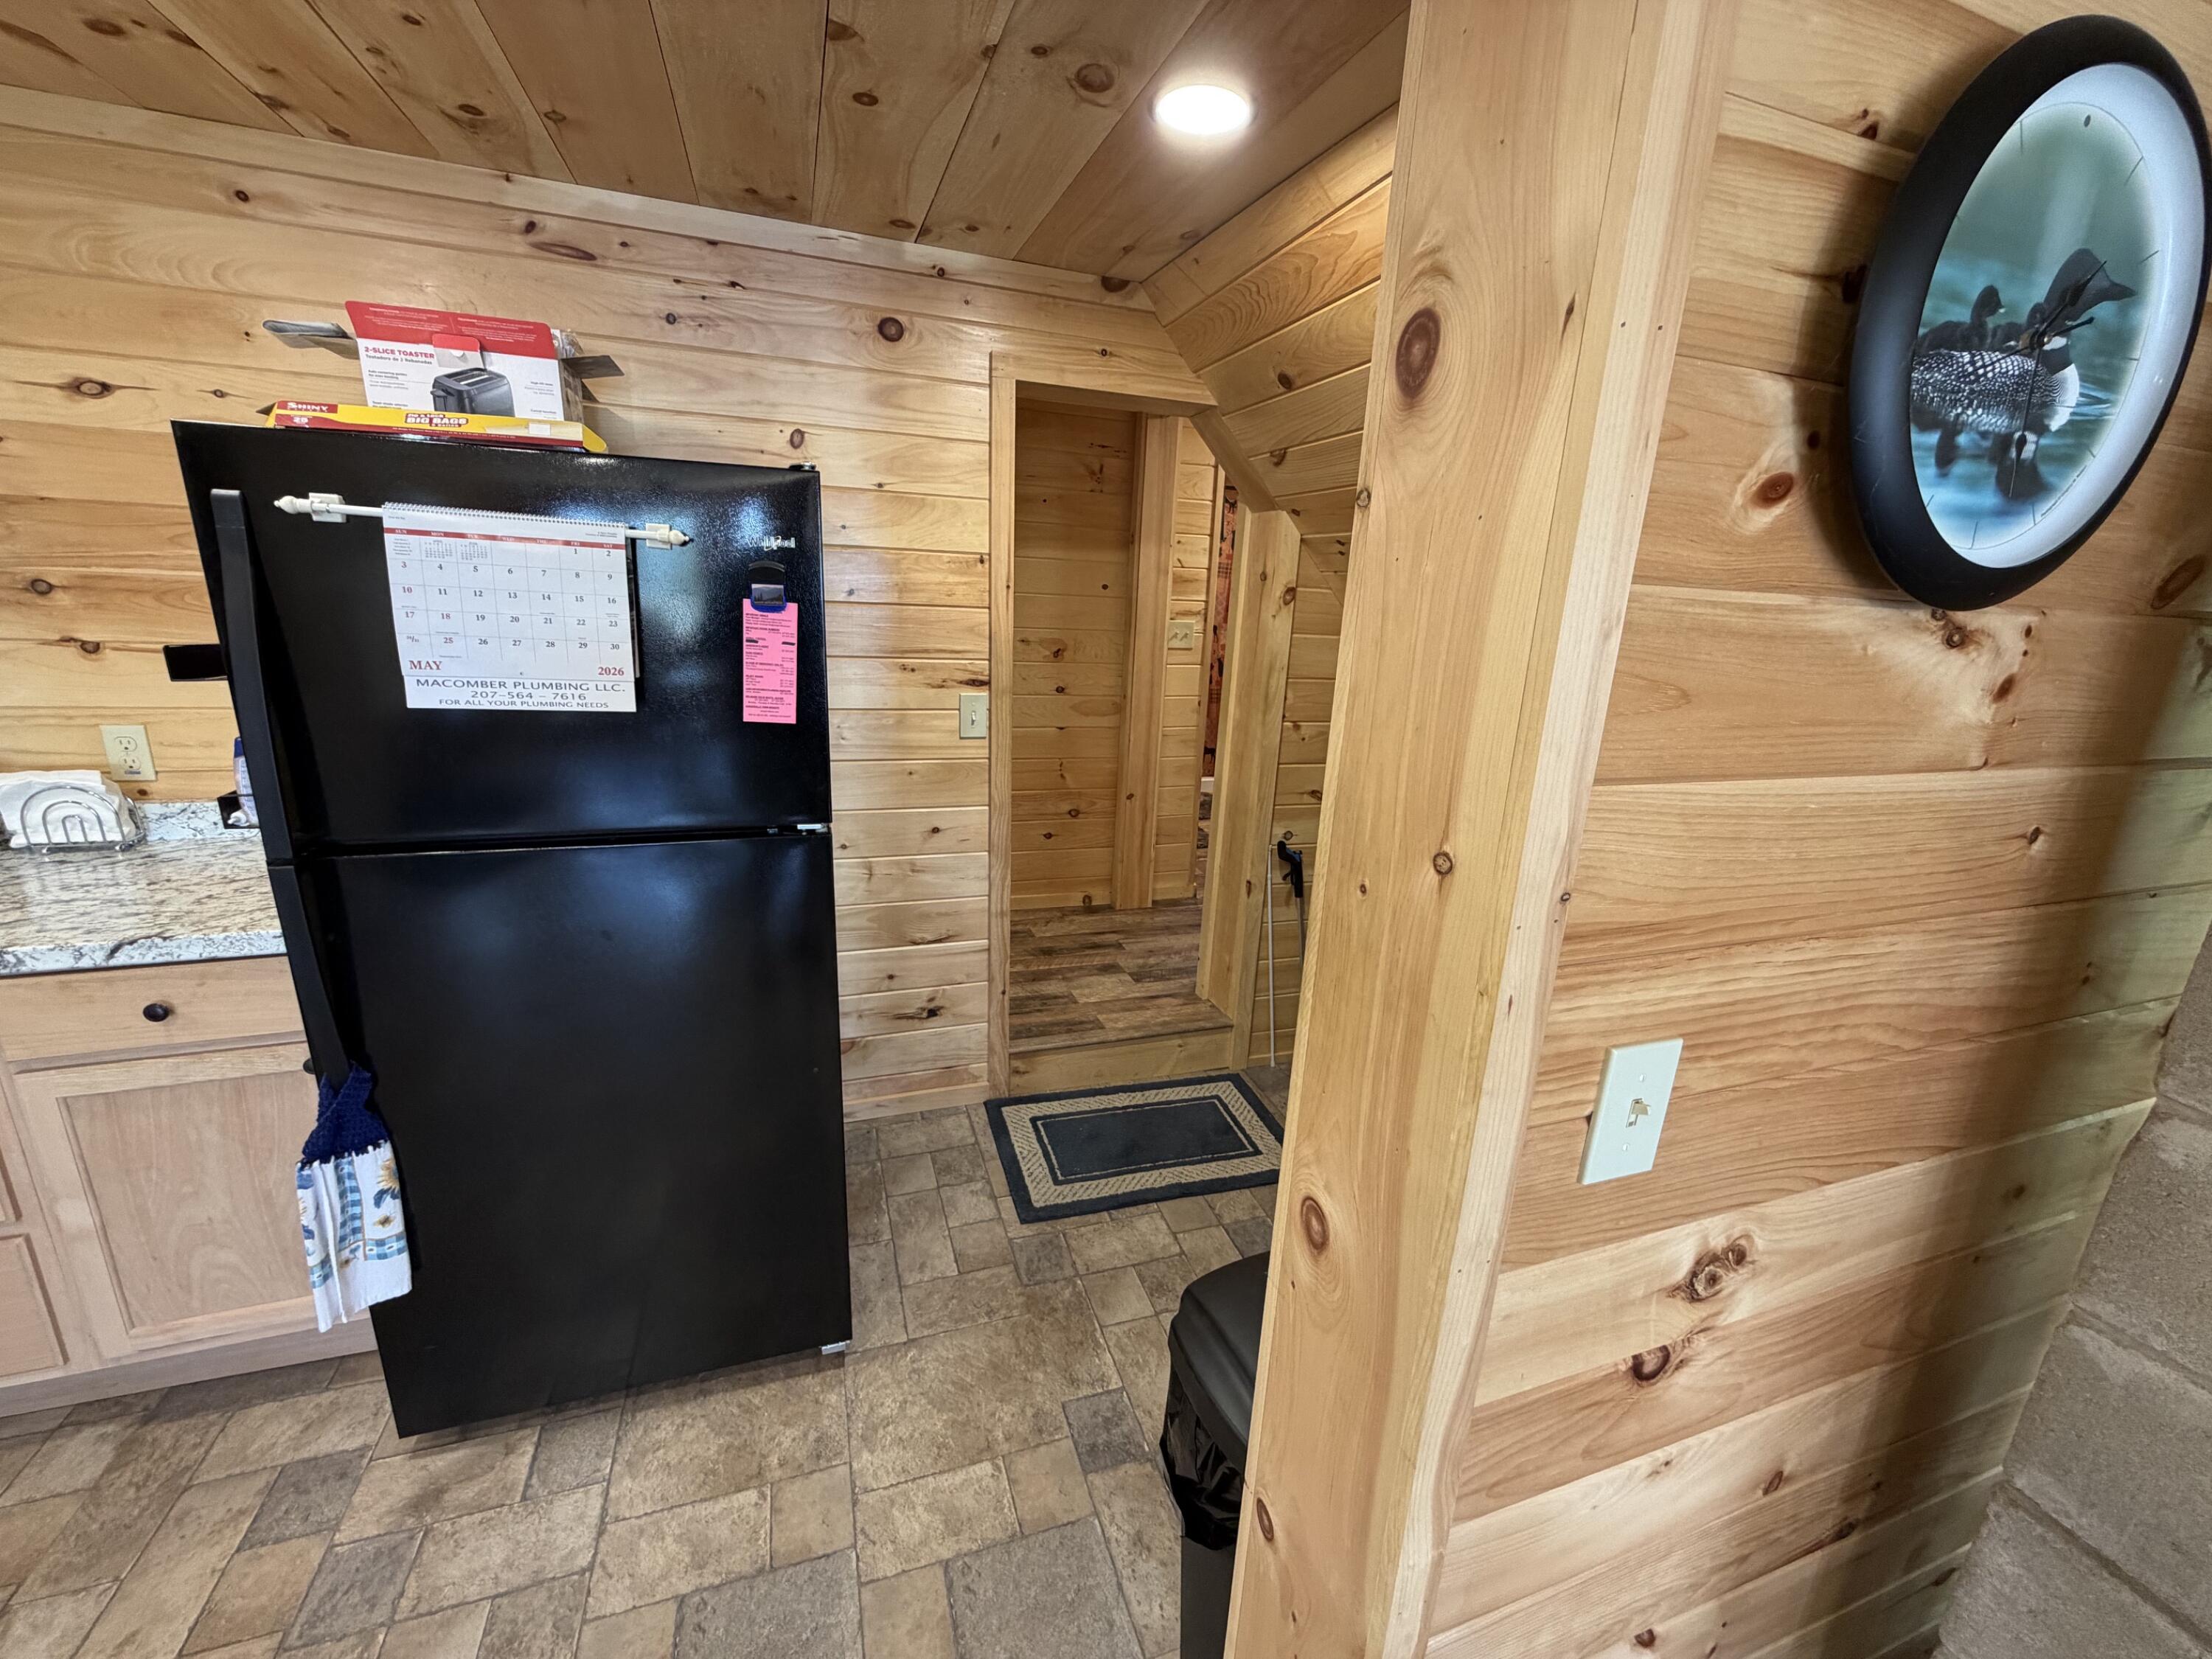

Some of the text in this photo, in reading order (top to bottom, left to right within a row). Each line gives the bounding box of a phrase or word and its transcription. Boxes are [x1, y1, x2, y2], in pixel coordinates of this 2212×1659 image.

[364, 347, 434, 359] 2-SLICE TOASTER
[409, 660, 625, 675] MAY 2026
[416, 678, 625, 692] MACOMBER PLUMBING LLC.
[552, 692, 586, 700] 7616
